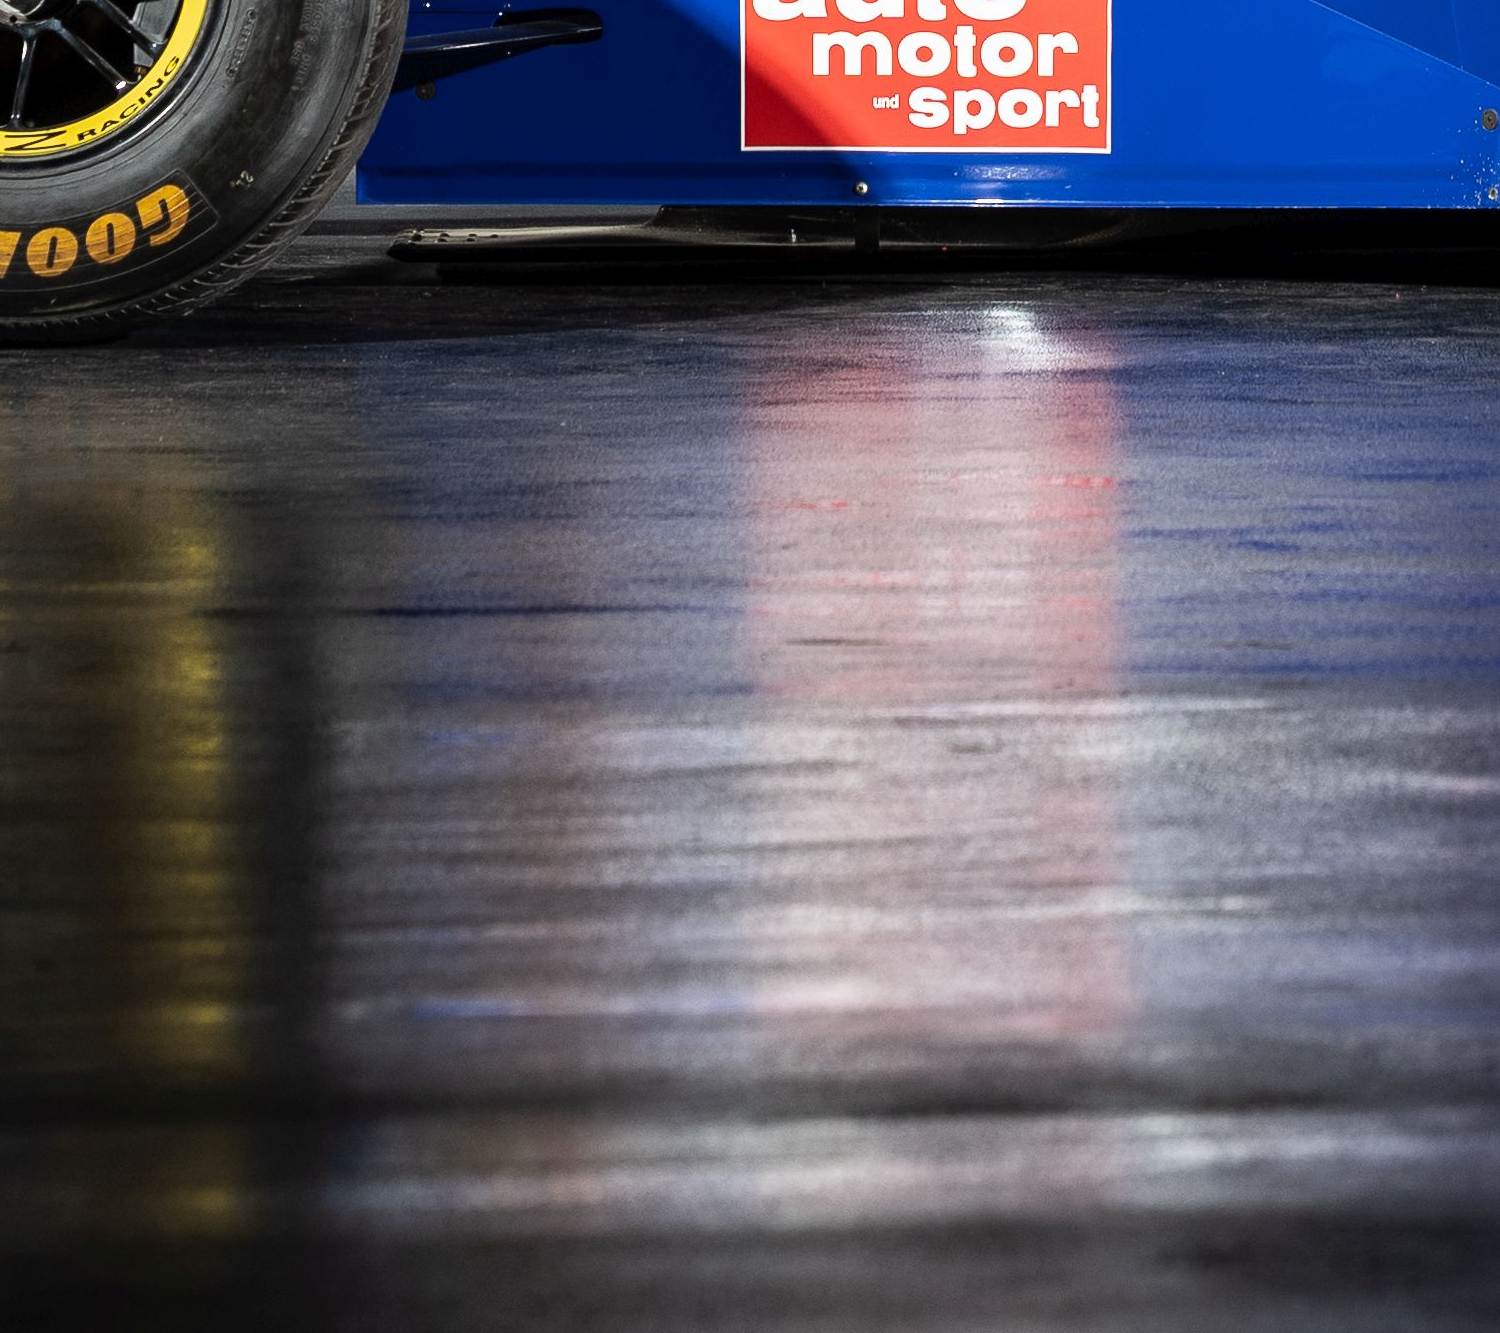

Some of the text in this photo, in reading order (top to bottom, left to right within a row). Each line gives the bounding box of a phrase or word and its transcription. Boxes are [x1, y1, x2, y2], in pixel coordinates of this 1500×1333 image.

[812, 25, 1079, 77] motor
[77, 56, 179, 141] RACING
[872, 85, 1100, 135] und sport
